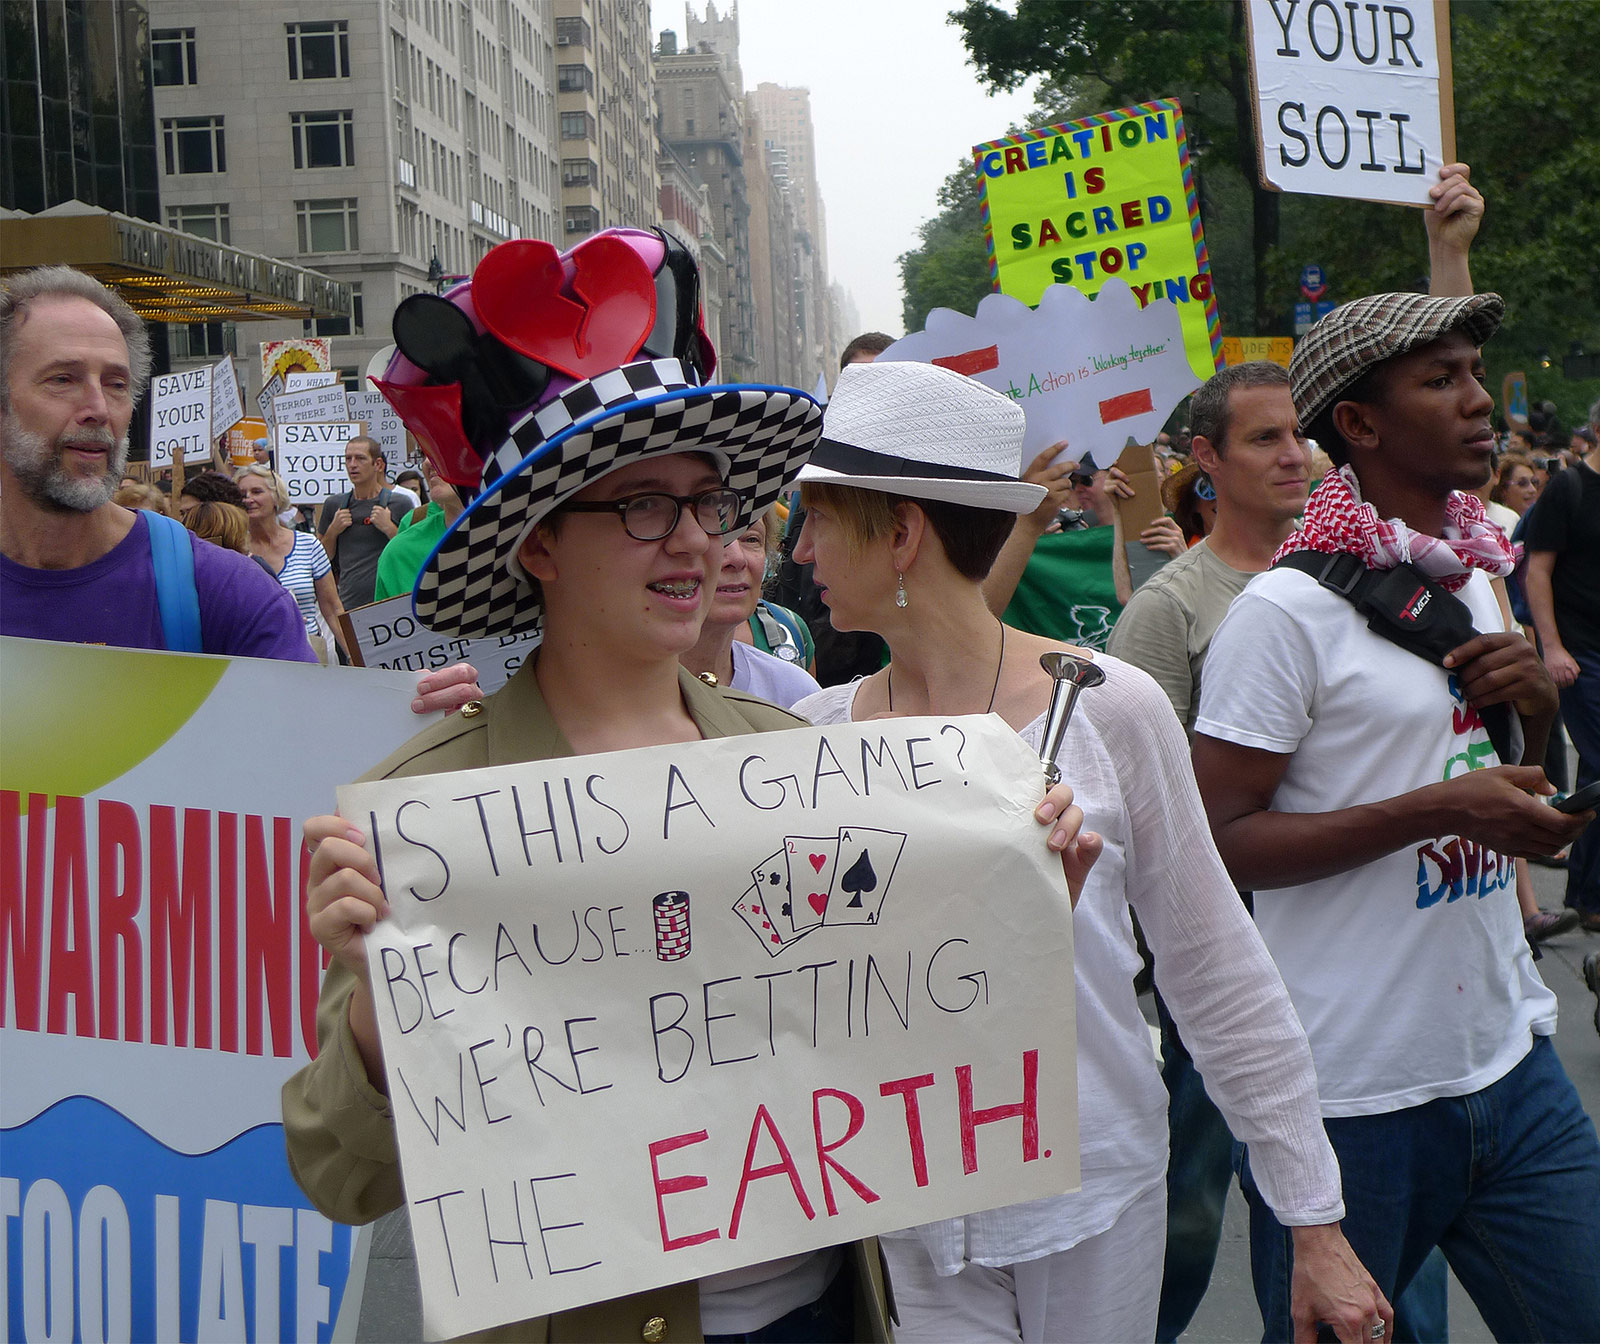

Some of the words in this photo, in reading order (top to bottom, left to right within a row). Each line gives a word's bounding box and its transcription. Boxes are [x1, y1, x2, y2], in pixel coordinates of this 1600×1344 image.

[1266, 0, 1423, 68] YOUR
[983, 112, 1169, 179] CREATION
[1278, 101, 1426, 175] SOIL
[1064, 166, 1106, 199] IS
[1011, 195, 1172, 250] SACRED
[1051, 242, 1147, 284] STOP
[1130, 273, 1212, 310] YING
[1224, 341, 1290, 355] STUDENTS
[158, 370, 205, 397] SAVE
[289, 379, 302, 388] DO
[306, 378, 331, 388] WHAT
[1028, 372, 1076, 397] Action
[1078, 366, 1090, 380] is
[275, 397, 313, 412] TERROR
[317, 391, 343, 404] ENDS
[294, 407, 326, 421] THERE
[332, 404, 345, 414] IS
[157, 402, 205, 428] YOUR
[351, 410, 374, 421] UST
[381, 421, 397, 430] SO
[155, 434, 204, 460] SOIL
[285, 425, 351, 443] SAVE
[381, 436, 398, 445] WE
[1400, 586, 1433, 621] TRACK
[369, 617, 415, 647] DO
[370, 800, 449, 902] IS
[452, 774, 629, 877] THIS
[664, 764, 716, 839] A
[739, 724, 969, 810] GAME?
[787, 841, 797, 853] 2
[842, 830, 852, 842] A
[757, 870, 765, 882] 5
[867, 911, 875, 924] A
[397, 1017, 613, 1146] WE'RE
[649, 937, 989, 1083] BETTING
[414, 1173, 602, 1297] THE
[648, 1049, 1052, 1252] EARTH.
